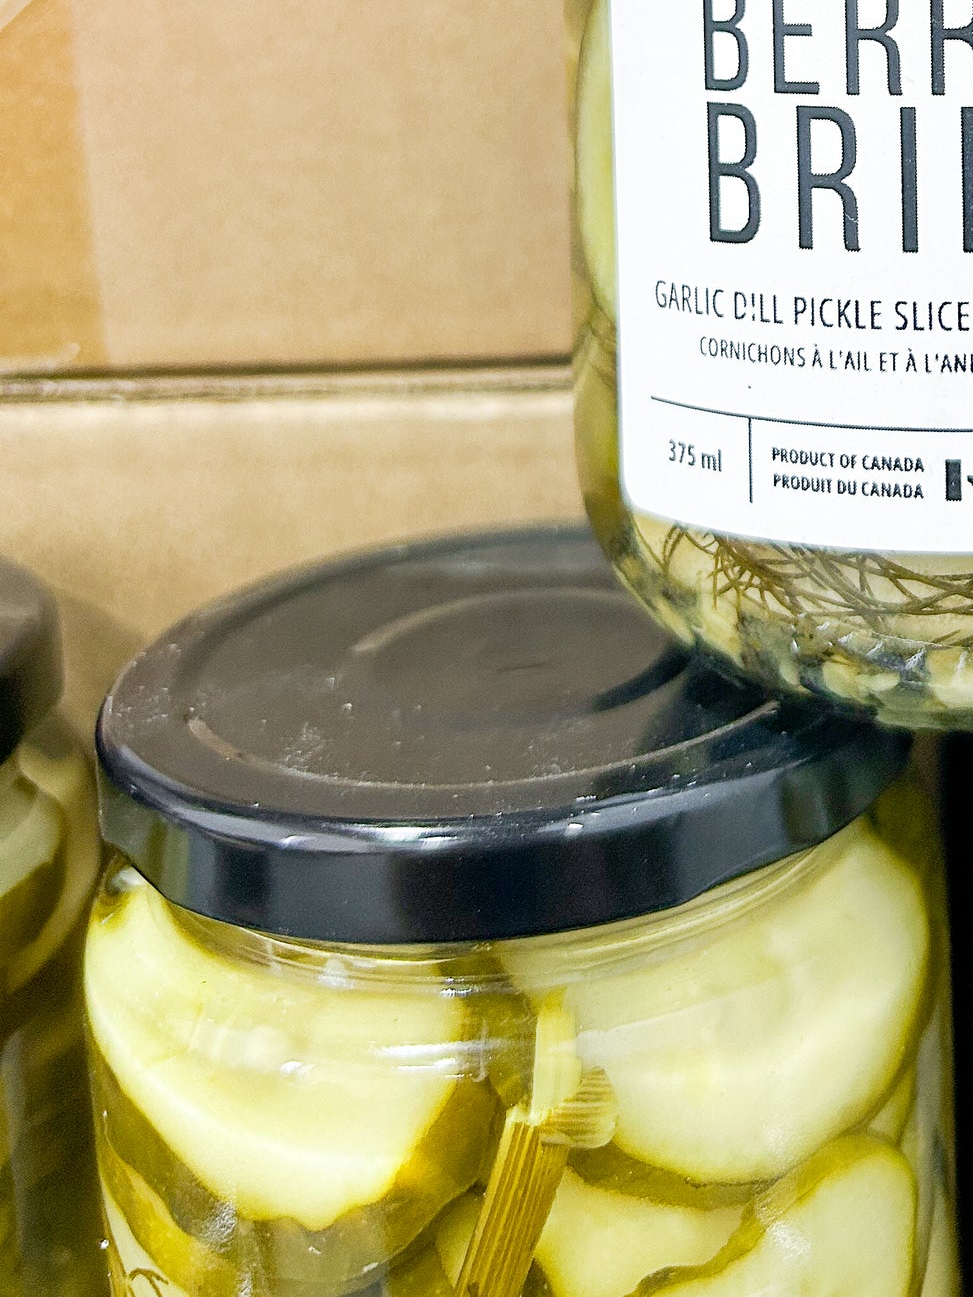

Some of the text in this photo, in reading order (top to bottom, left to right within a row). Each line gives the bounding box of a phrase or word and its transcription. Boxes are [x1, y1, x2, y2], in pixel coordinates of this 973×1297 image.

[654, 280, 725, 319] GARLIC
[794, 298, 882, 331] PICKLE
[699, 336, 806, 369] CORNICHONS
[811, 342, 824, 369] À
[830, 351, 873, 372] L'AIL
[879, 351, 898, 372] ET
[905, 347, 918, 373] À
[668, 439, 723, 472] 375 ml
[771, 447, 925, 473] PRODUCT OF CANADA
[773, 473, 924, 499] PRODUIT DU CANADA
